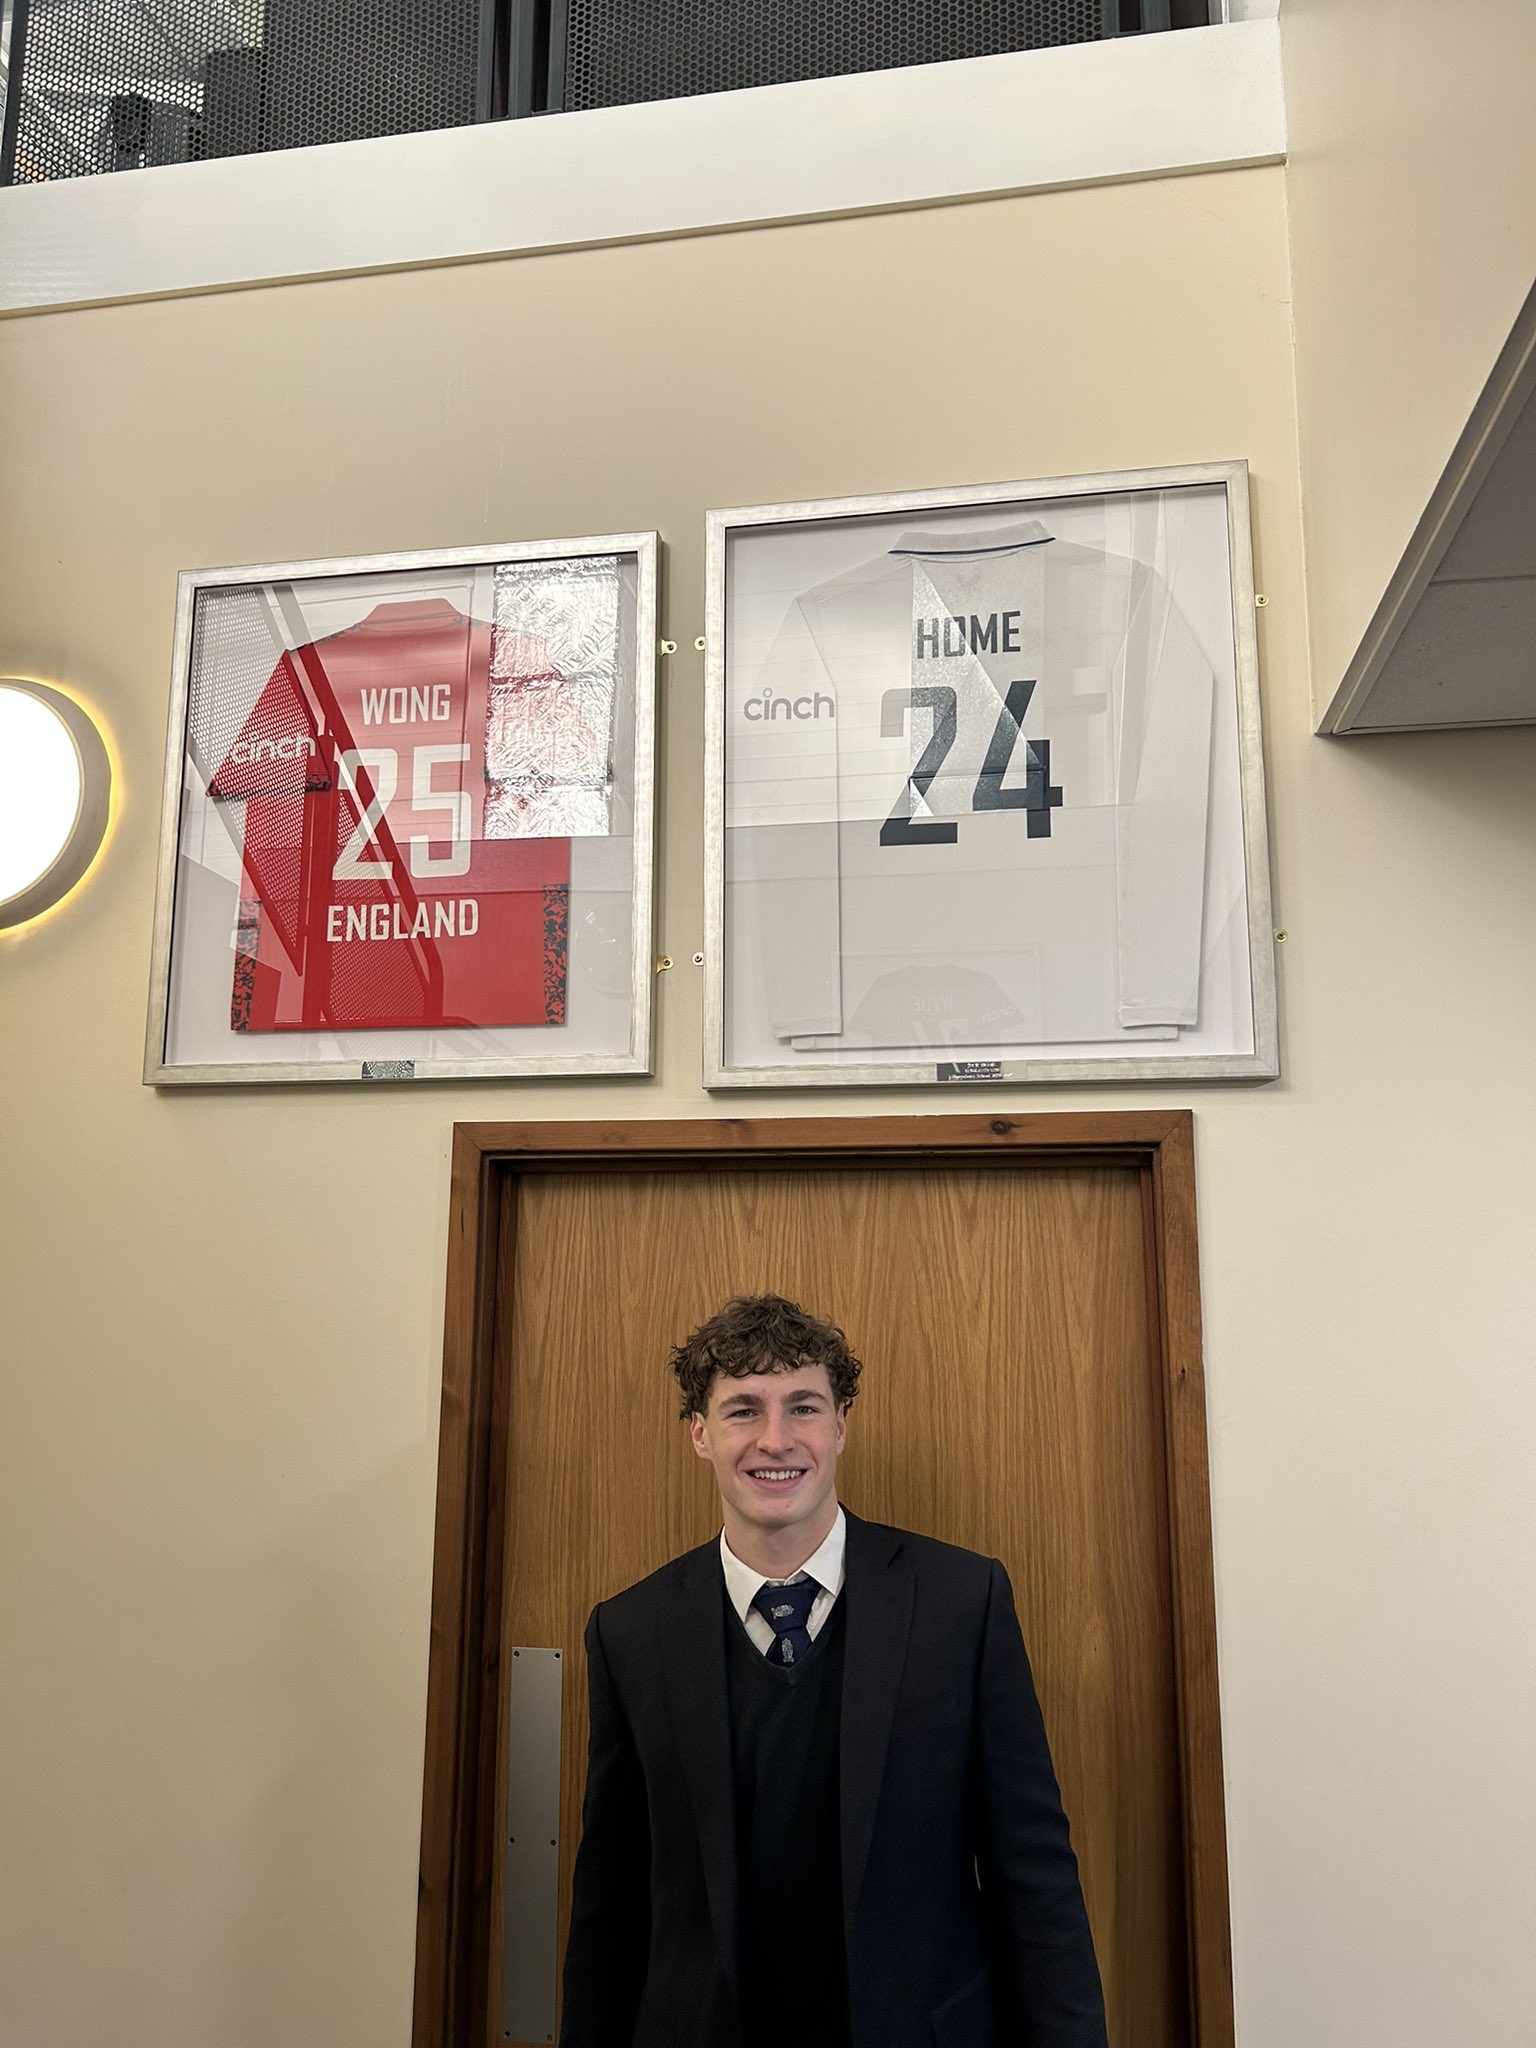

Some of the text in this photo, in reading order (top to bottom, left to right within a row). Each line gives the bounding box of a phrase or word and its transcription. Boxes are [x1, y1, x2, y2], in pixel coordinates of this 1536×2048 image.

[917, 610, 1021, 659] HOME
[360, 683, 451, 725] WONG
[743, 687, 835, 721] cinch
[231, 729, 316, 764] cinch
[879, 679, 1063, 846] 24
[332, 743, 472, 880] 25
[326, 898, 479, 942] ENGLAND
